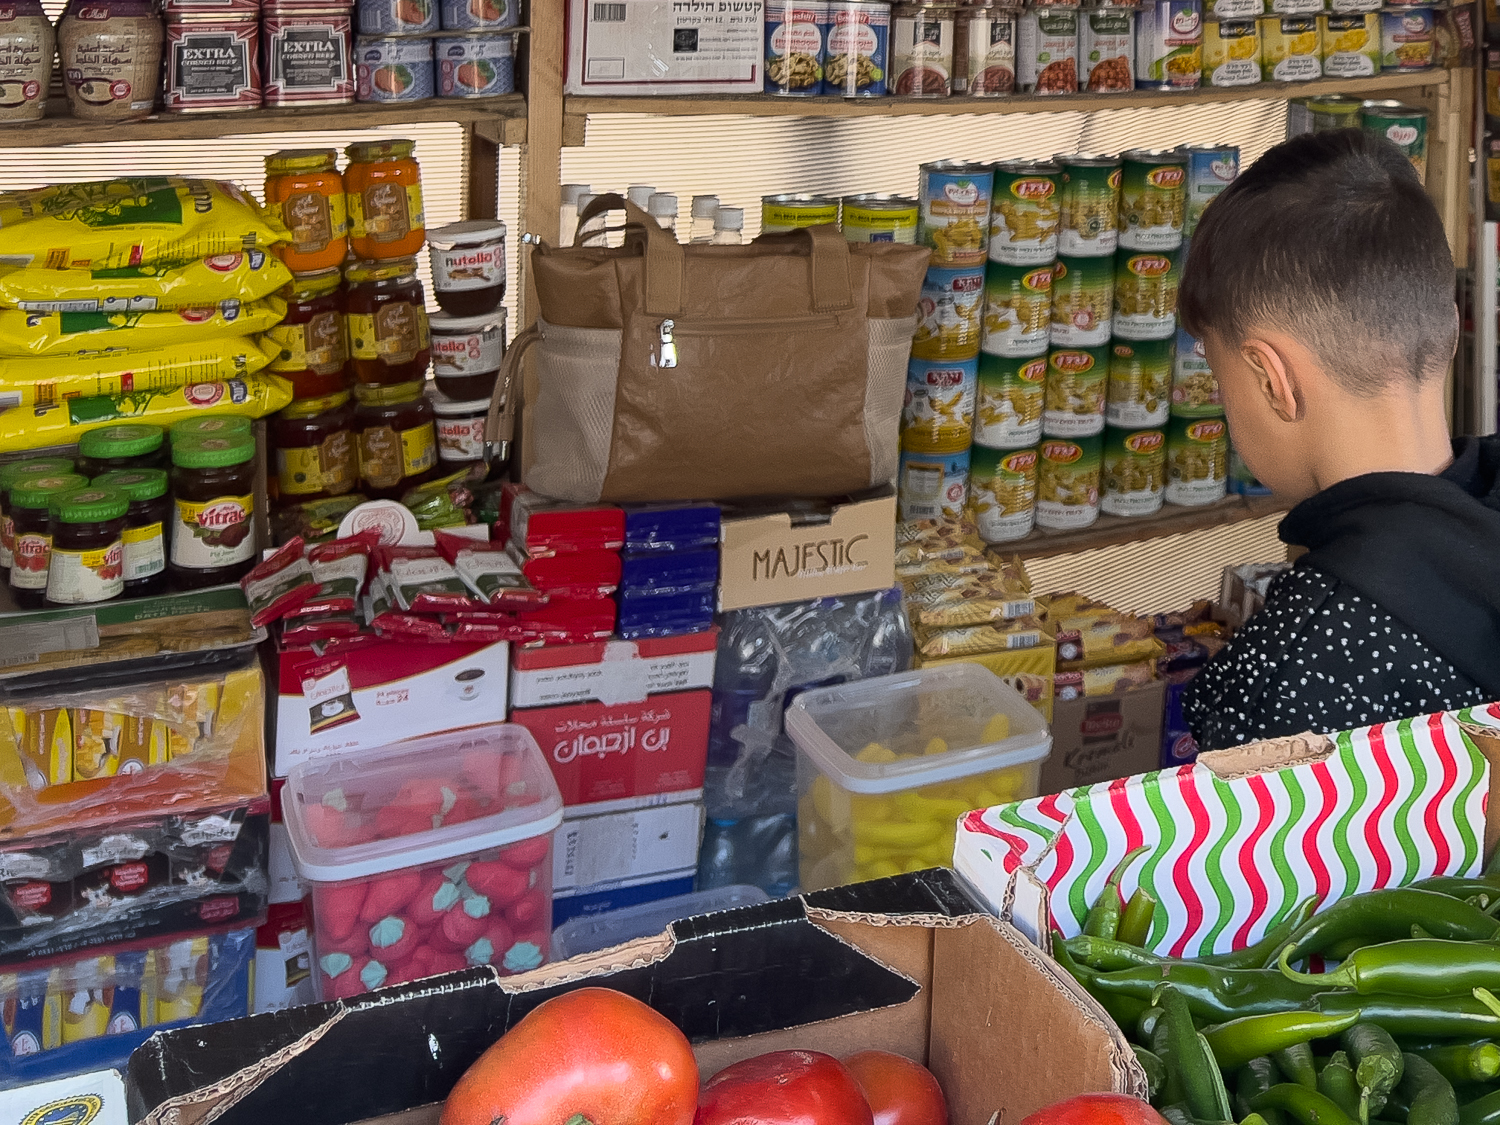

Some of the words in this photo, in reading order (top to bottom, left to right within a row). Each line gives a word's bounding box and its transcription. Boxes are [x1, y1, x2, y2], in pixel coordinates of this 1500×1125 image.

[718, 1, 762, 15] קטשופ
[183, 47, 236, 59] EXTRA
[284, 40, 335, 53] EXTRA
[446, 250, 492, 266] nutella
[198, 508, 245, 527] Vitrac
[752, 533, 869, 581] MAJESTIC
